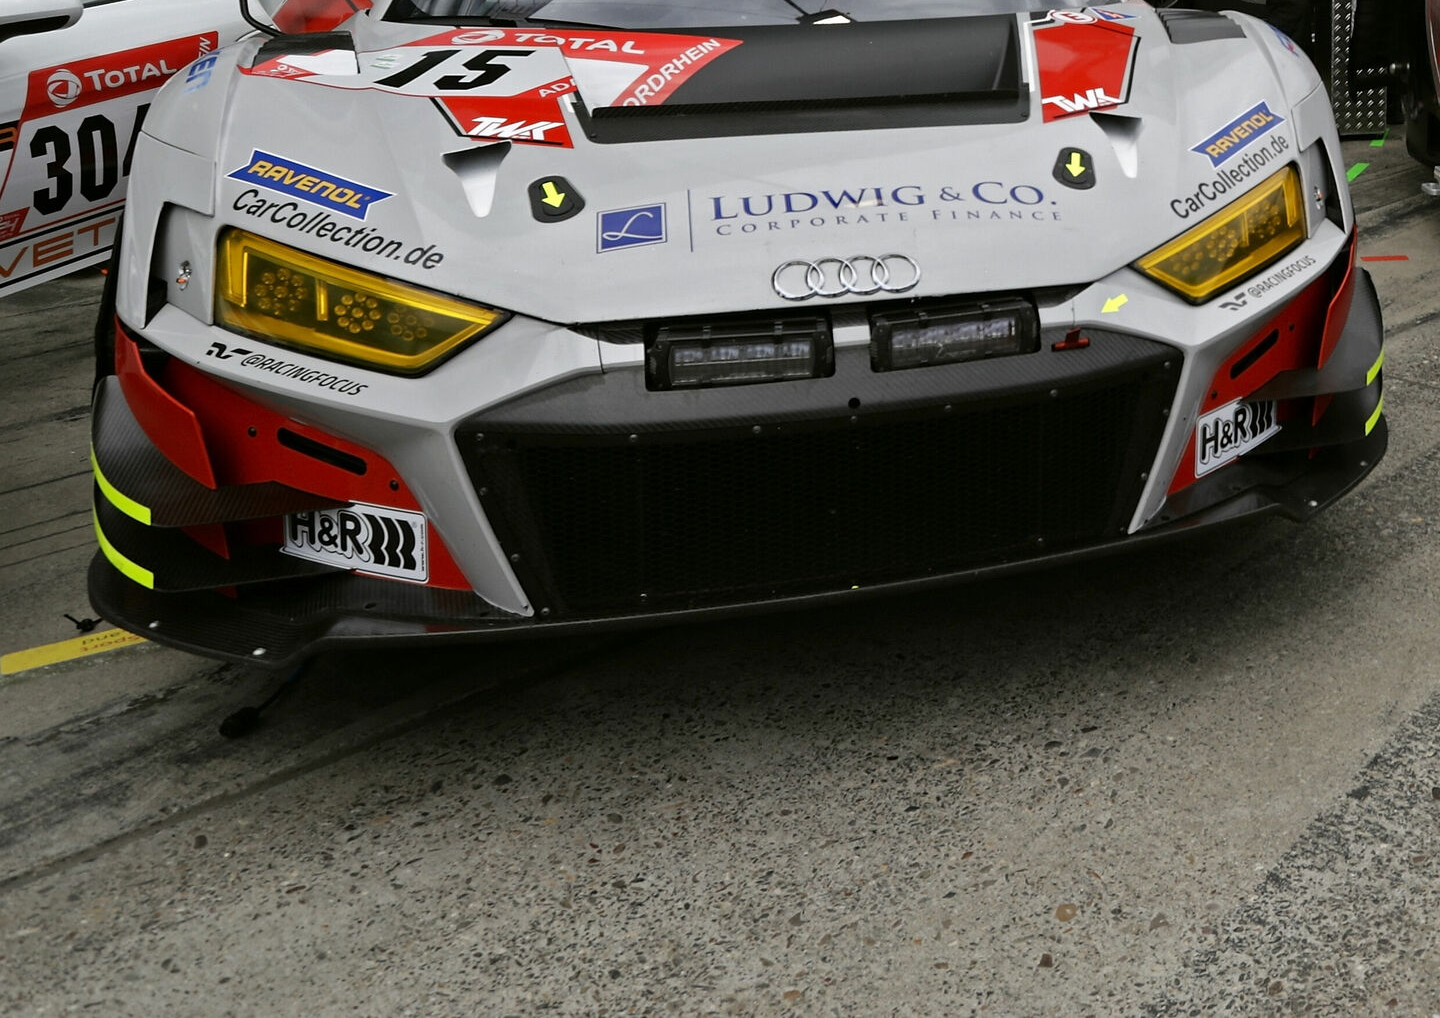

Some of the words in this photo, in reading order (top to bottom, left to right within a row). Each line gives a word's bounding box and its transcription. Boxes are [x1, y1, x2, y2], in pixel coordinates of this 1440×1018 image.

[513, 33, 645, 55] TOTAL
[84, 58, 178, 92] TOTAL
[374, 49, 537, 91] 15
[1205, 110, 1275, 159] RAVENOL
[247, 160, 367, 209] RAVENOL
[1169, 134, 1289, 219] CarCollection.de
[709, 185, 926, 221] LUDWIG
[716, 211, 909, 237] CORPORATE
[932, 208, 1062, 222] FINANCE
[232, 189, 444, 270] CarCollection.de
[1247, 254, 1316, 299] @RACINGFOCUS
[240, 353, 369, 396] @RACINGFOCUS
[1201, 405, 1248, 461] H&R
[290, 511, 365, 556] H&R
